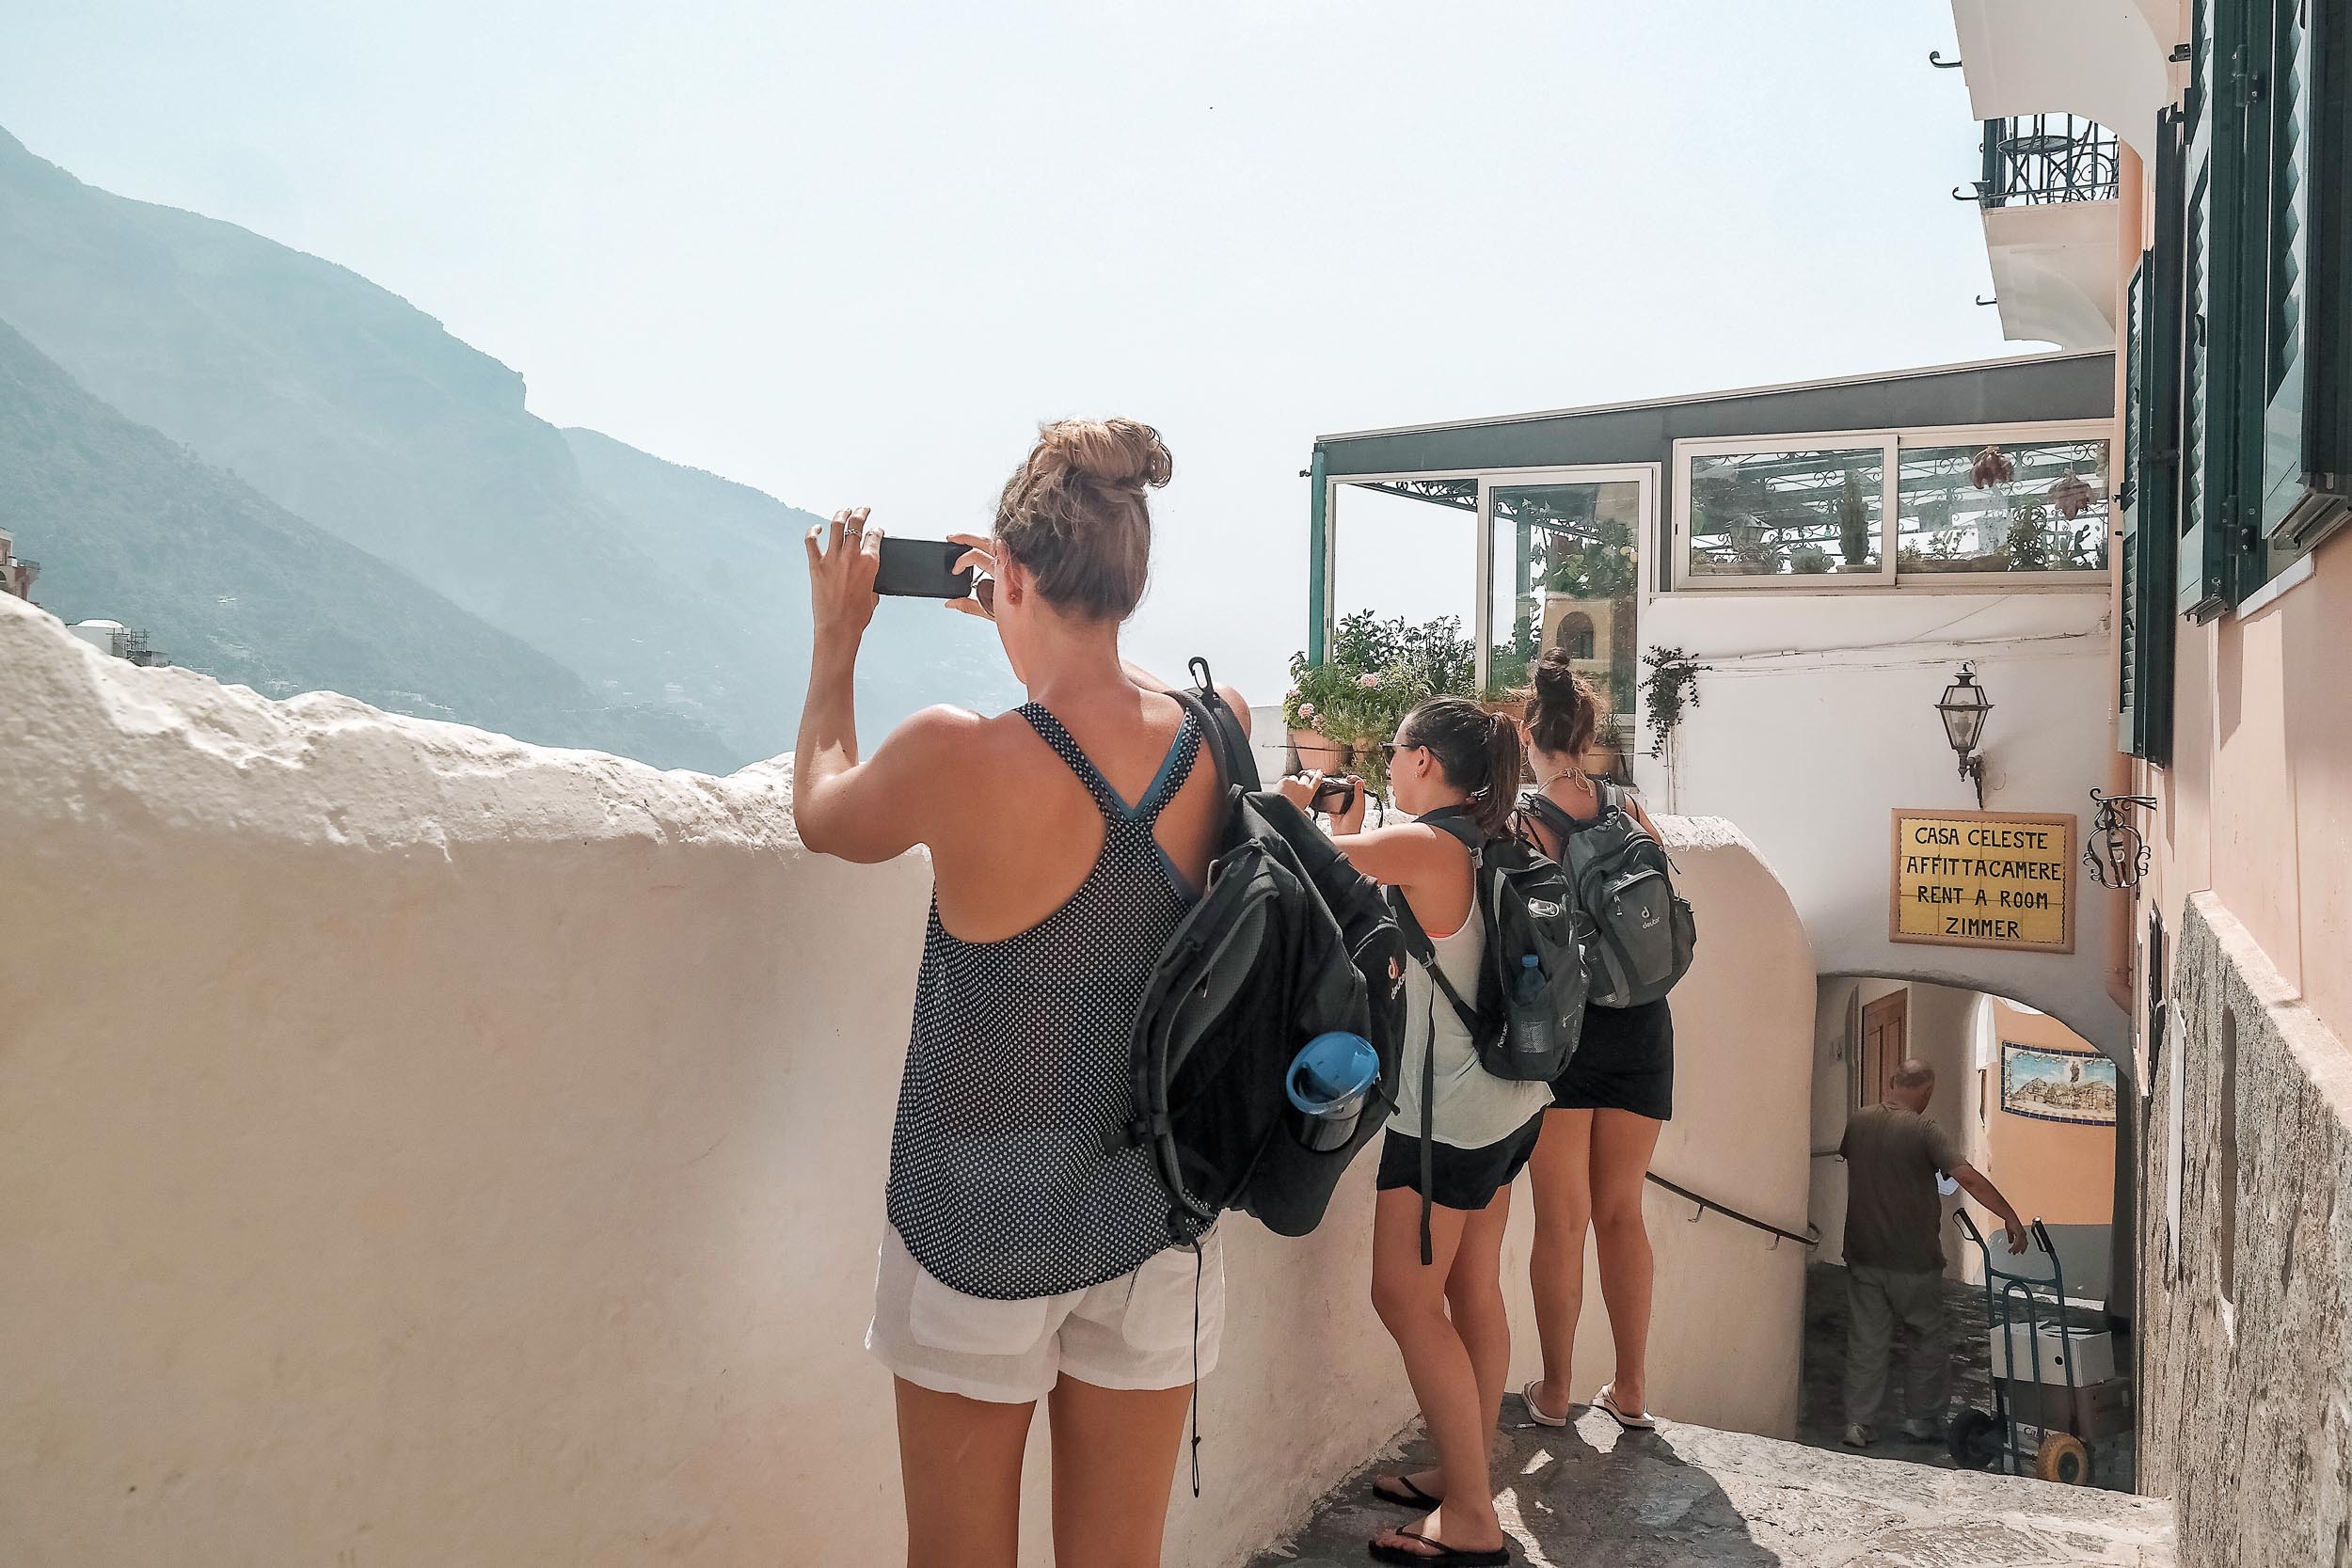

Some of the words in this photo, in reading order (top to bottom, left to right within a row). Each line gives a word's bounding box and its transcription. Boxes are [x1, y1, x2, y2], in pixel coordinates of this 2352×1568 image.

[1915, 827, 1960, 845] CASA
[1967, 829, 2048, 849] CELESTE
[1907, 856, 2061, 880] AFFITTACAMERE
[1917, 885, 1963, 904] RENT
[1975, 889, 1987, 906] A
[2000, 890, 2048, 910] ROOM
[1946, 917, 2020, 939] ZIMMER
